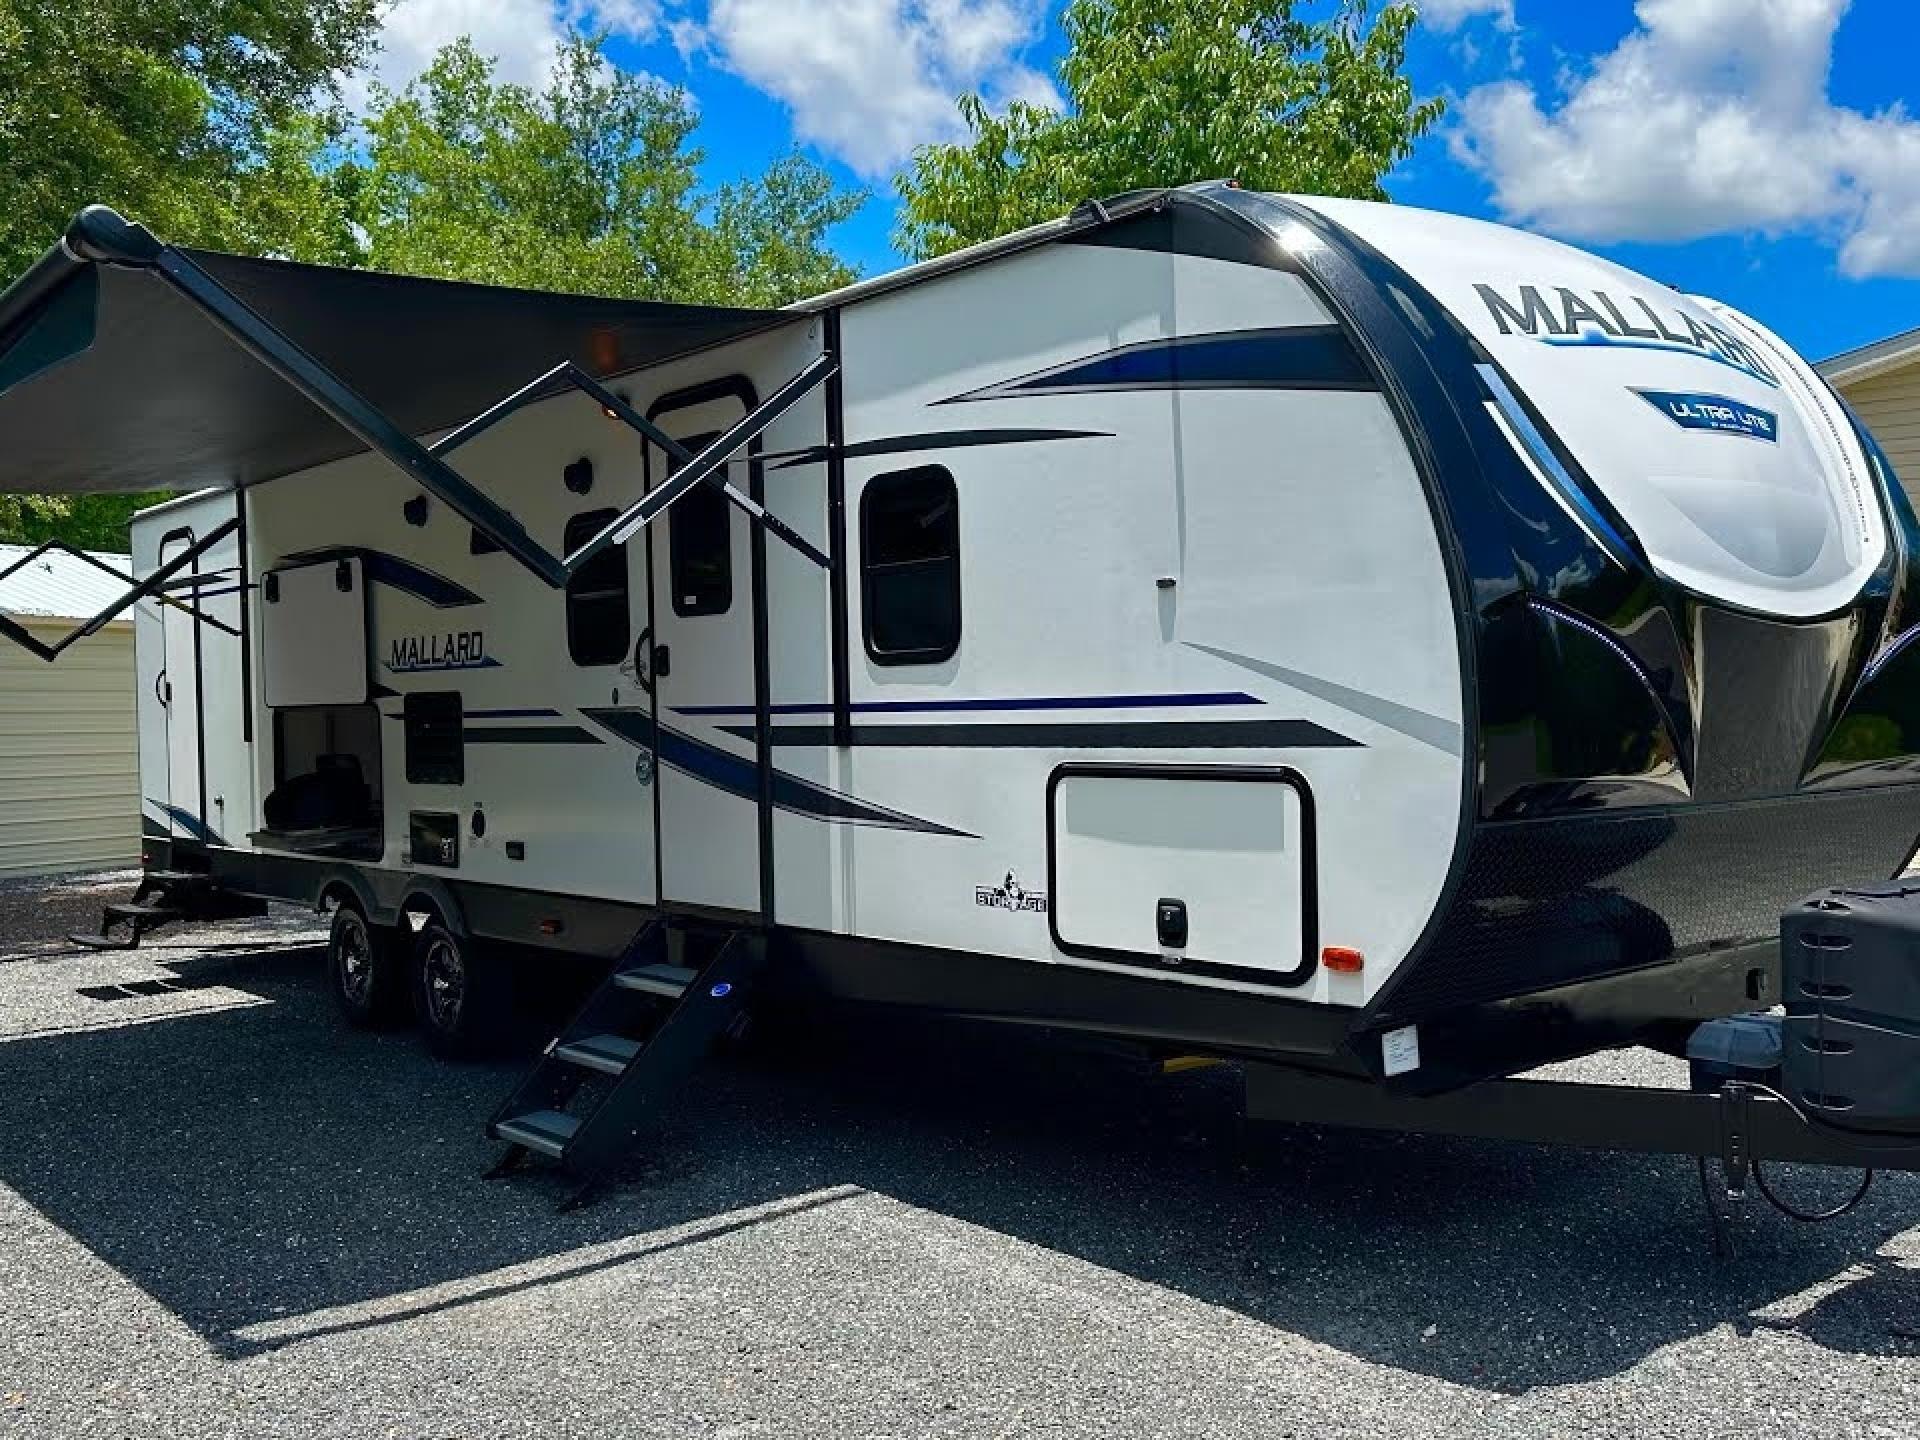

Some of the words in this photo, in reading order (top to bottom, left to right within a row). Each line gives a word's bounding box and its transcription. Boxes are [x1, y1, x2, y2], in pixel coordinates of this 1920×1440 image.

[1472, 284, 1779, 383] MALLARD
[1670, 401, 1737, 422] ULTRA
[391, 631, 483, 668] MALLARD
